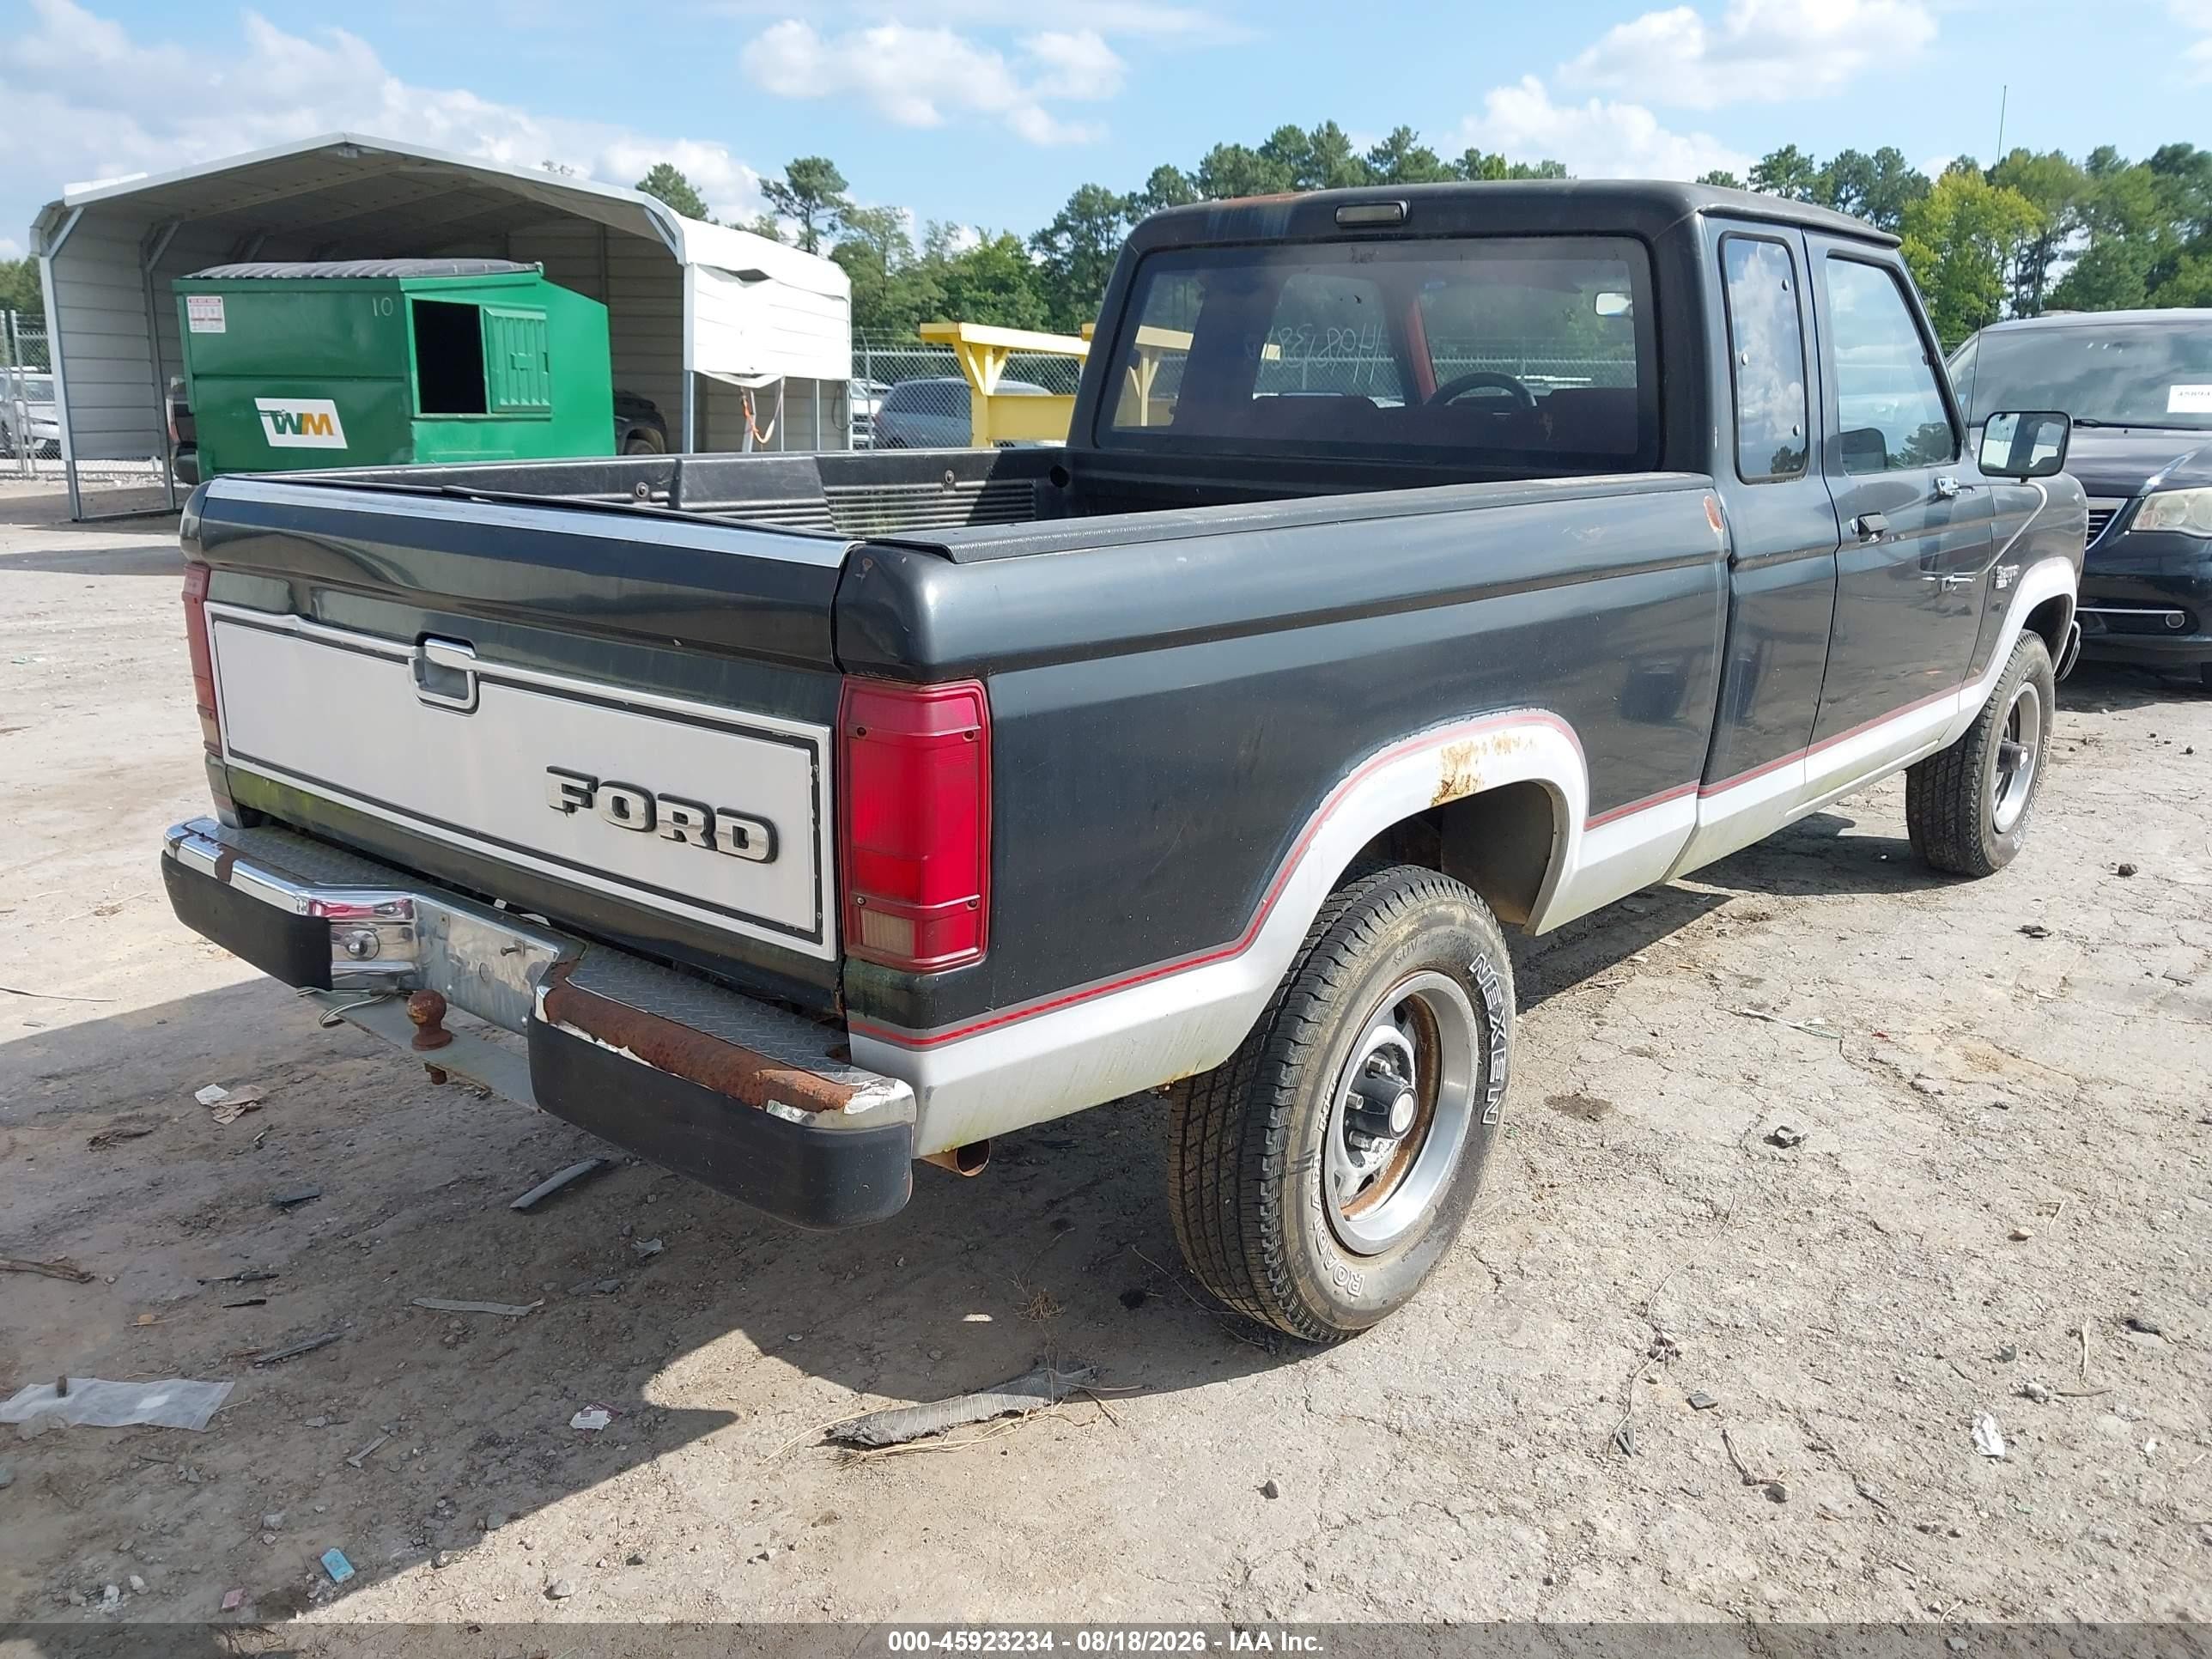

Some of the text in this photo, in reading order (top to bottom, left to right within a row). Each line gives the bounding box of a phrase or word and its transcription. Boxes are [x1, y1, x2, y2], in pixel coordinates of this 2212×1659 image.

[372, 296, 393, 317] 10
[270, 411, 334, 435] WM
[545, 765, 779, 864] FORD
[1468, 952, 1507, 1125] NEXEN
[1311, 1153, 1365, 1297] ROADIAN
